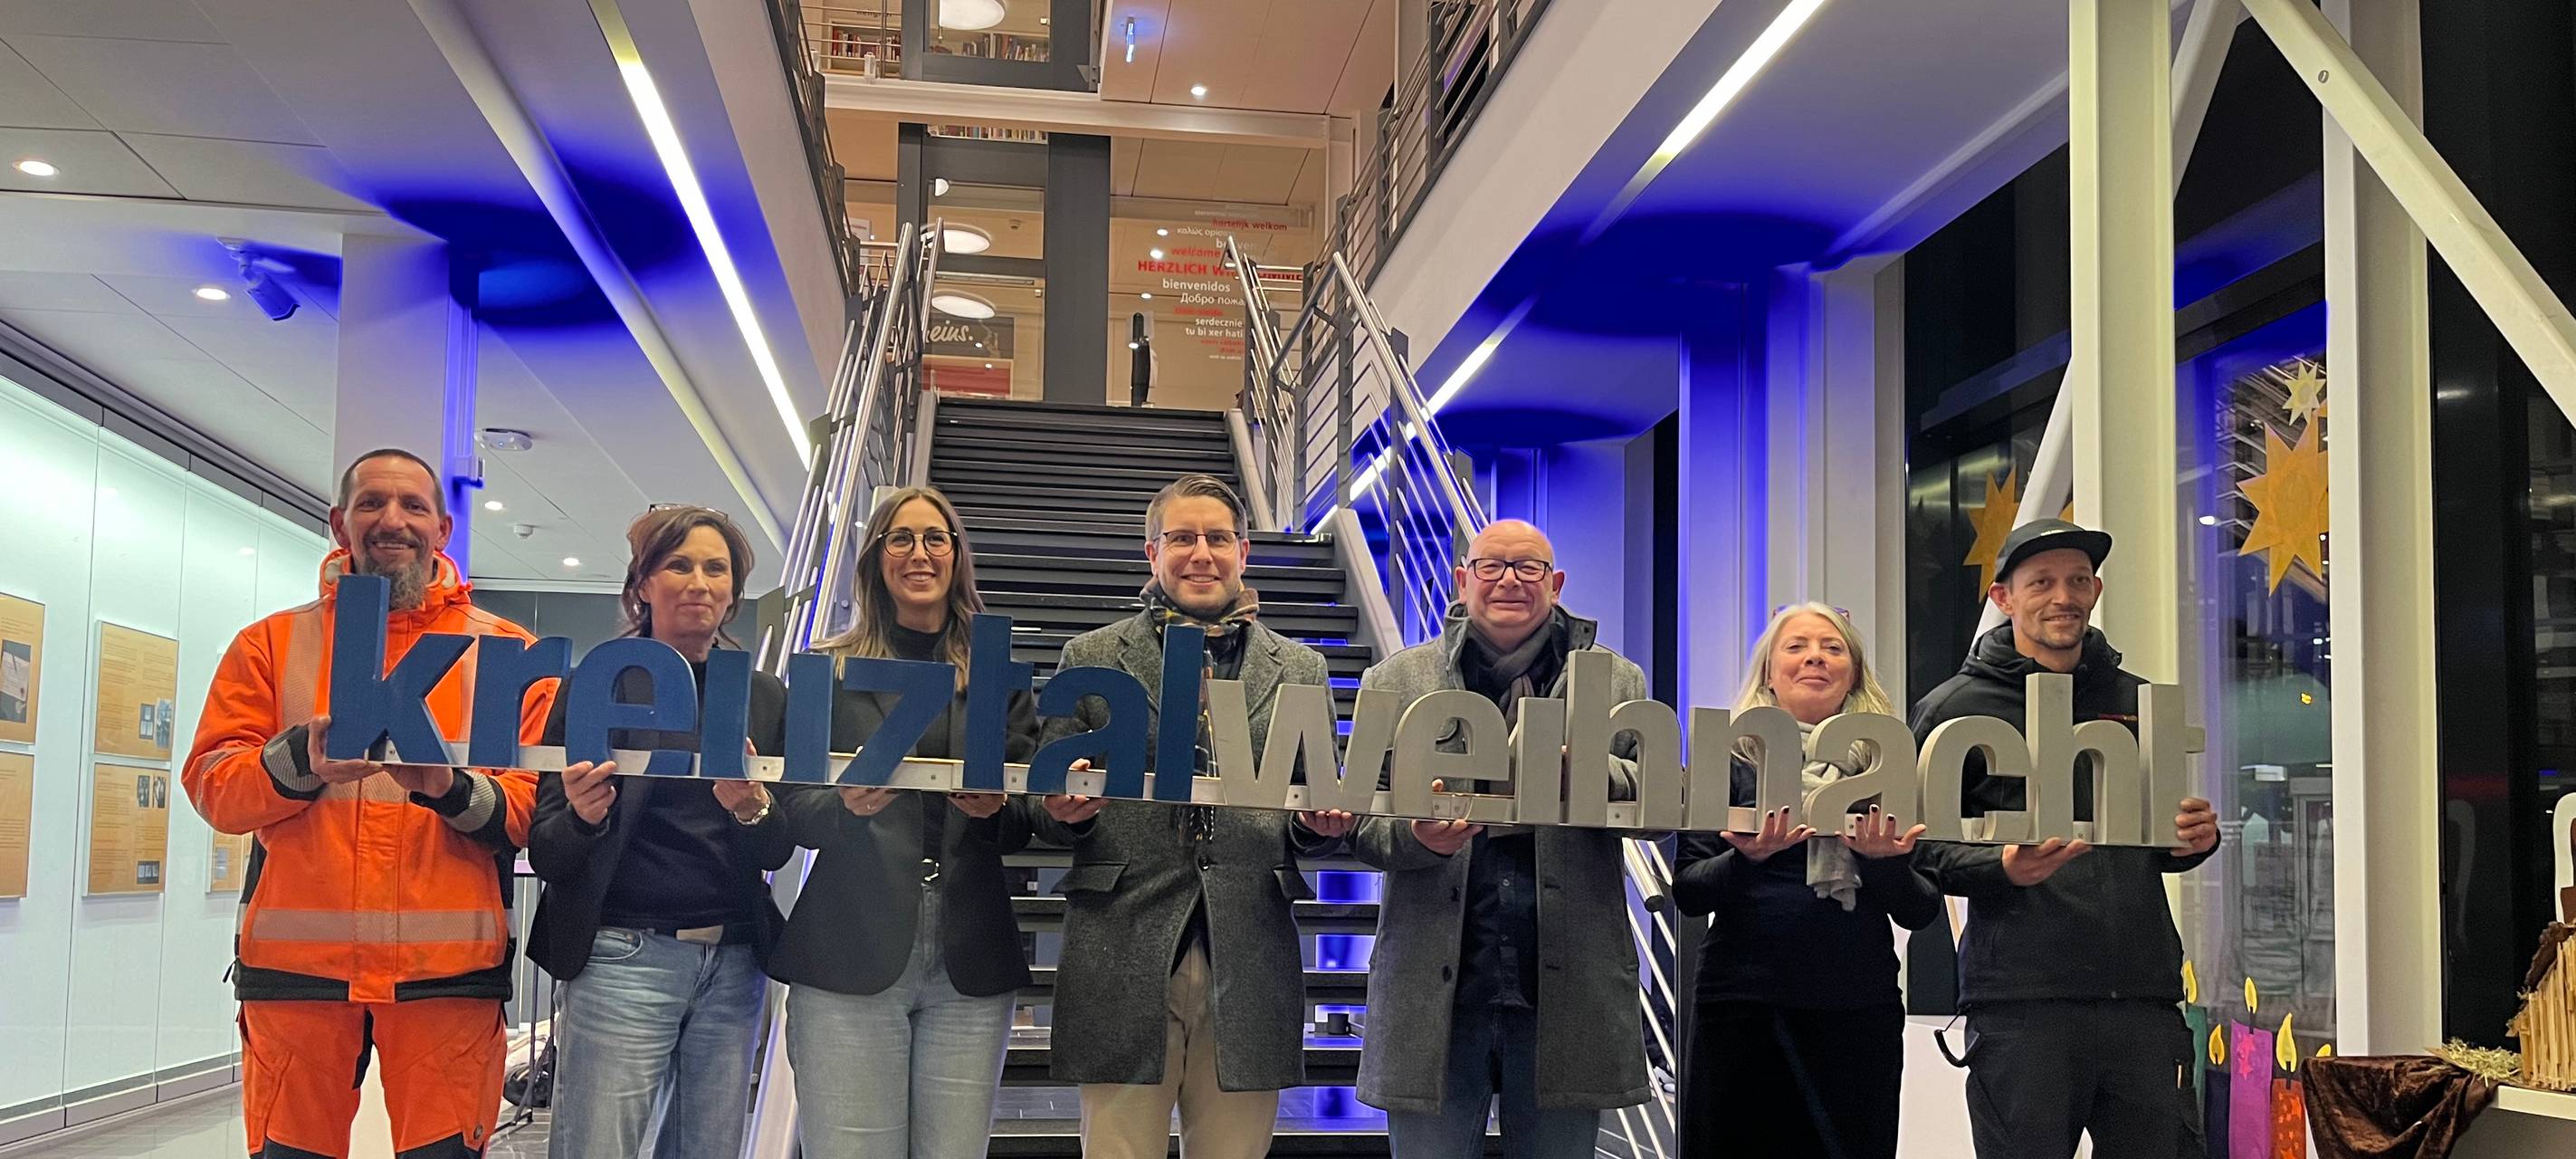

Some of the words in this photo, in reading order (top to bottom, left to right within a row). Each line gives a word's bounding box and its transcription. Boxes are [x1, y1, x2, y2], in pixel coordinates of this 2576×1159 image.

[1252, 221, 1288, 232] welkom
[1171, 247, 1221, 258] welcome
[1138, 260, 1207, 275] HERZLICH
[1162, 277, 1231, 292] bienvenidos
[1179, 292, 1216, 305] Добро
[1195, 317, 1243, 329] serdecznie
[1186, 328, 1196, 336] tu
[1197, 327, 1207, 337] bi
[1208, 330, 1224, 338] xer
[1225, 329, 1244, 339] hati
